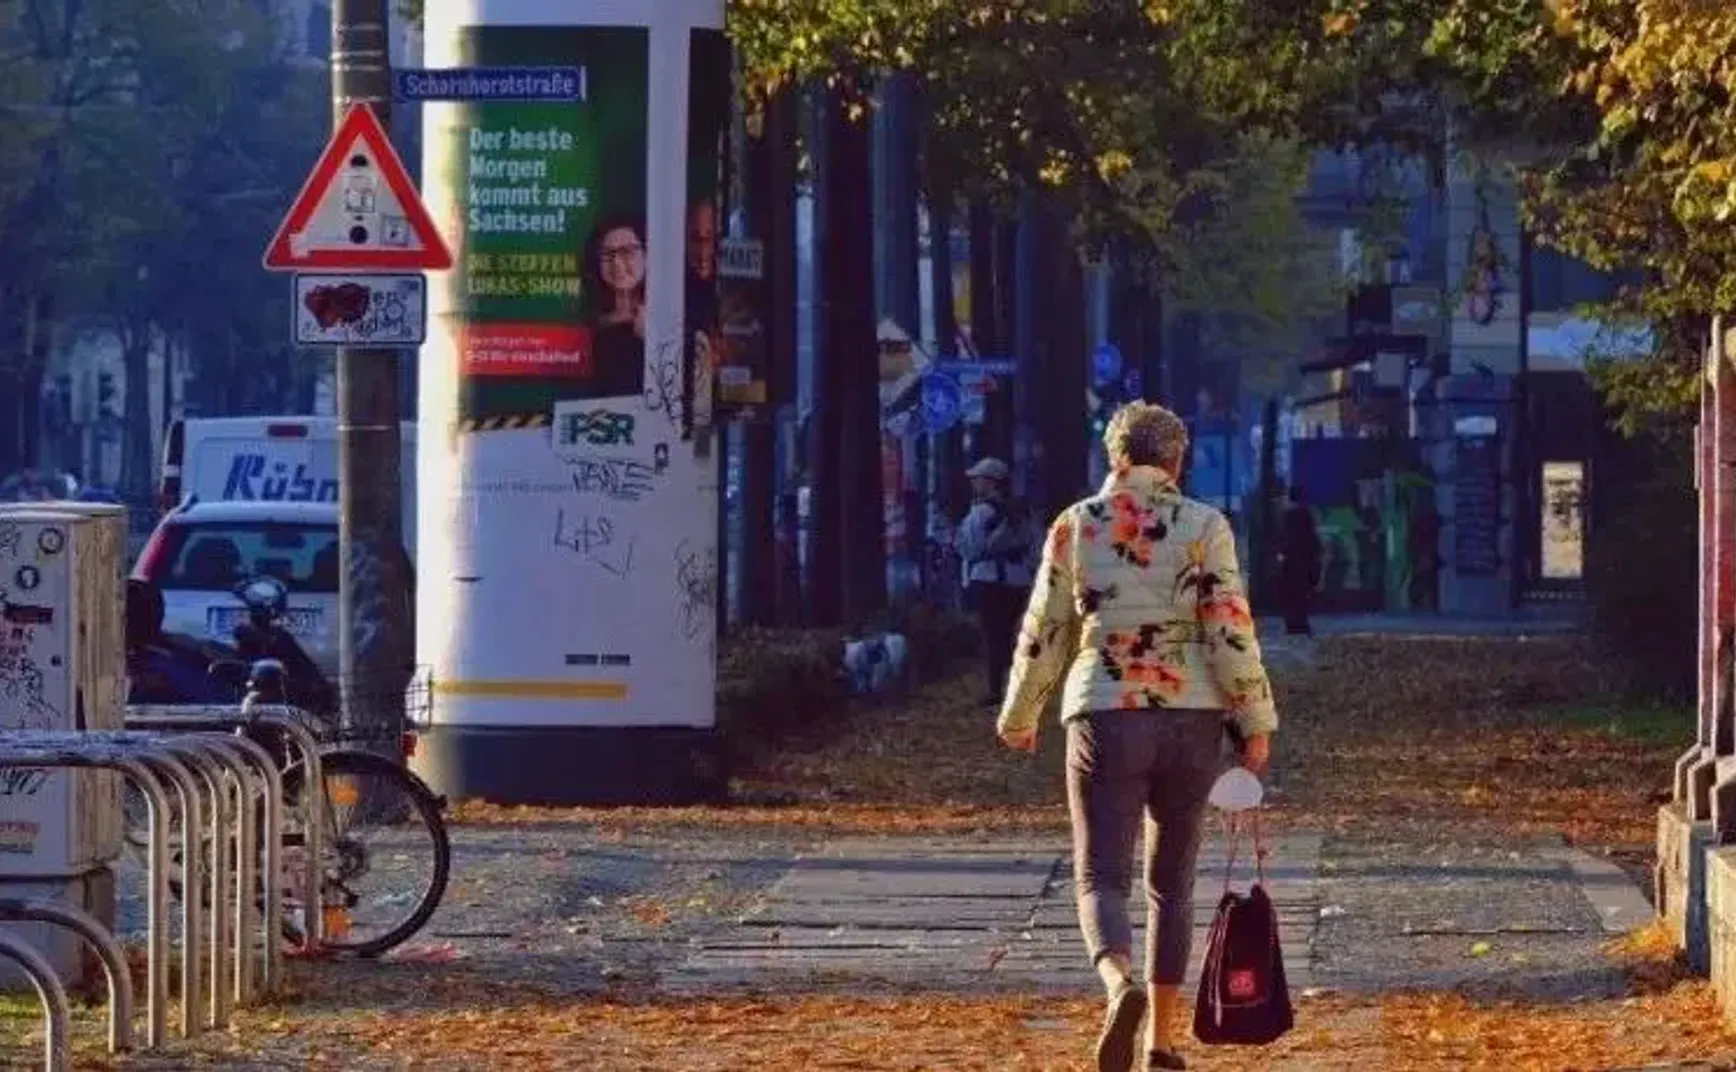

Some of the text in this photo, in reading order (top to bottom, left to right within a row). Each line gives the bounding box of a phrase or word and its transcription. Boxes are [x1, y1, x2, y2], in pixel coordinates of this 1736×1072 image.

[469, 127, 573, 151] Der beste
[469, 155, 547, 184] Morgen
[469, 183, 588, 207] kommt aus
[468, 208, 566, 232] Sachsen!
[569, 411, 635, 446] PSR
